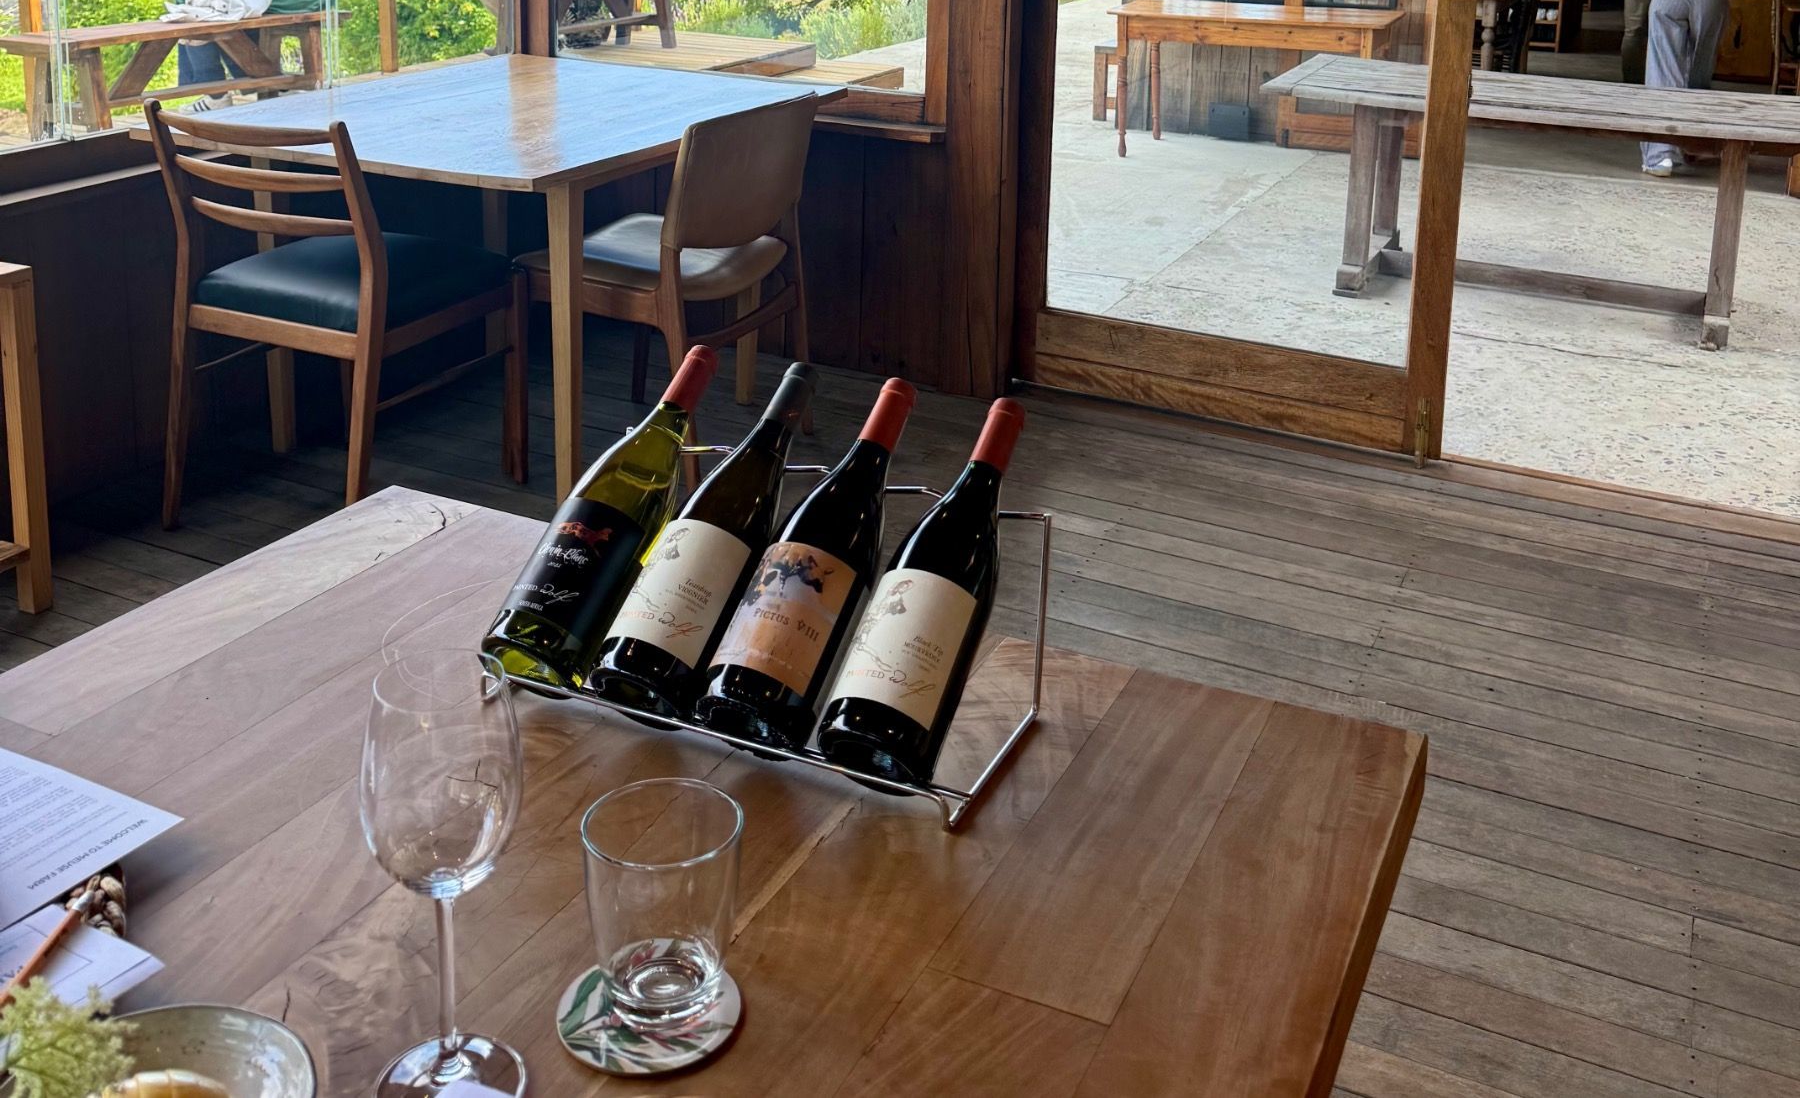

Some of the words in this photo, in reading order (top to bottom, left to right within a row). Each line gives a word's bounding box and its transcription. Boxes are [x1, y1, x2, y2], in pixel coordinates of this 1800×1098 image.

[678, 584, 709, 605] VIOGNIER
[753, 608, 790, 625] PICTUS
[102, 819, 148, 847] WELCOME
[59, 851, 90, 873] MEUSE
[27, 871, 57, 890] FARM
